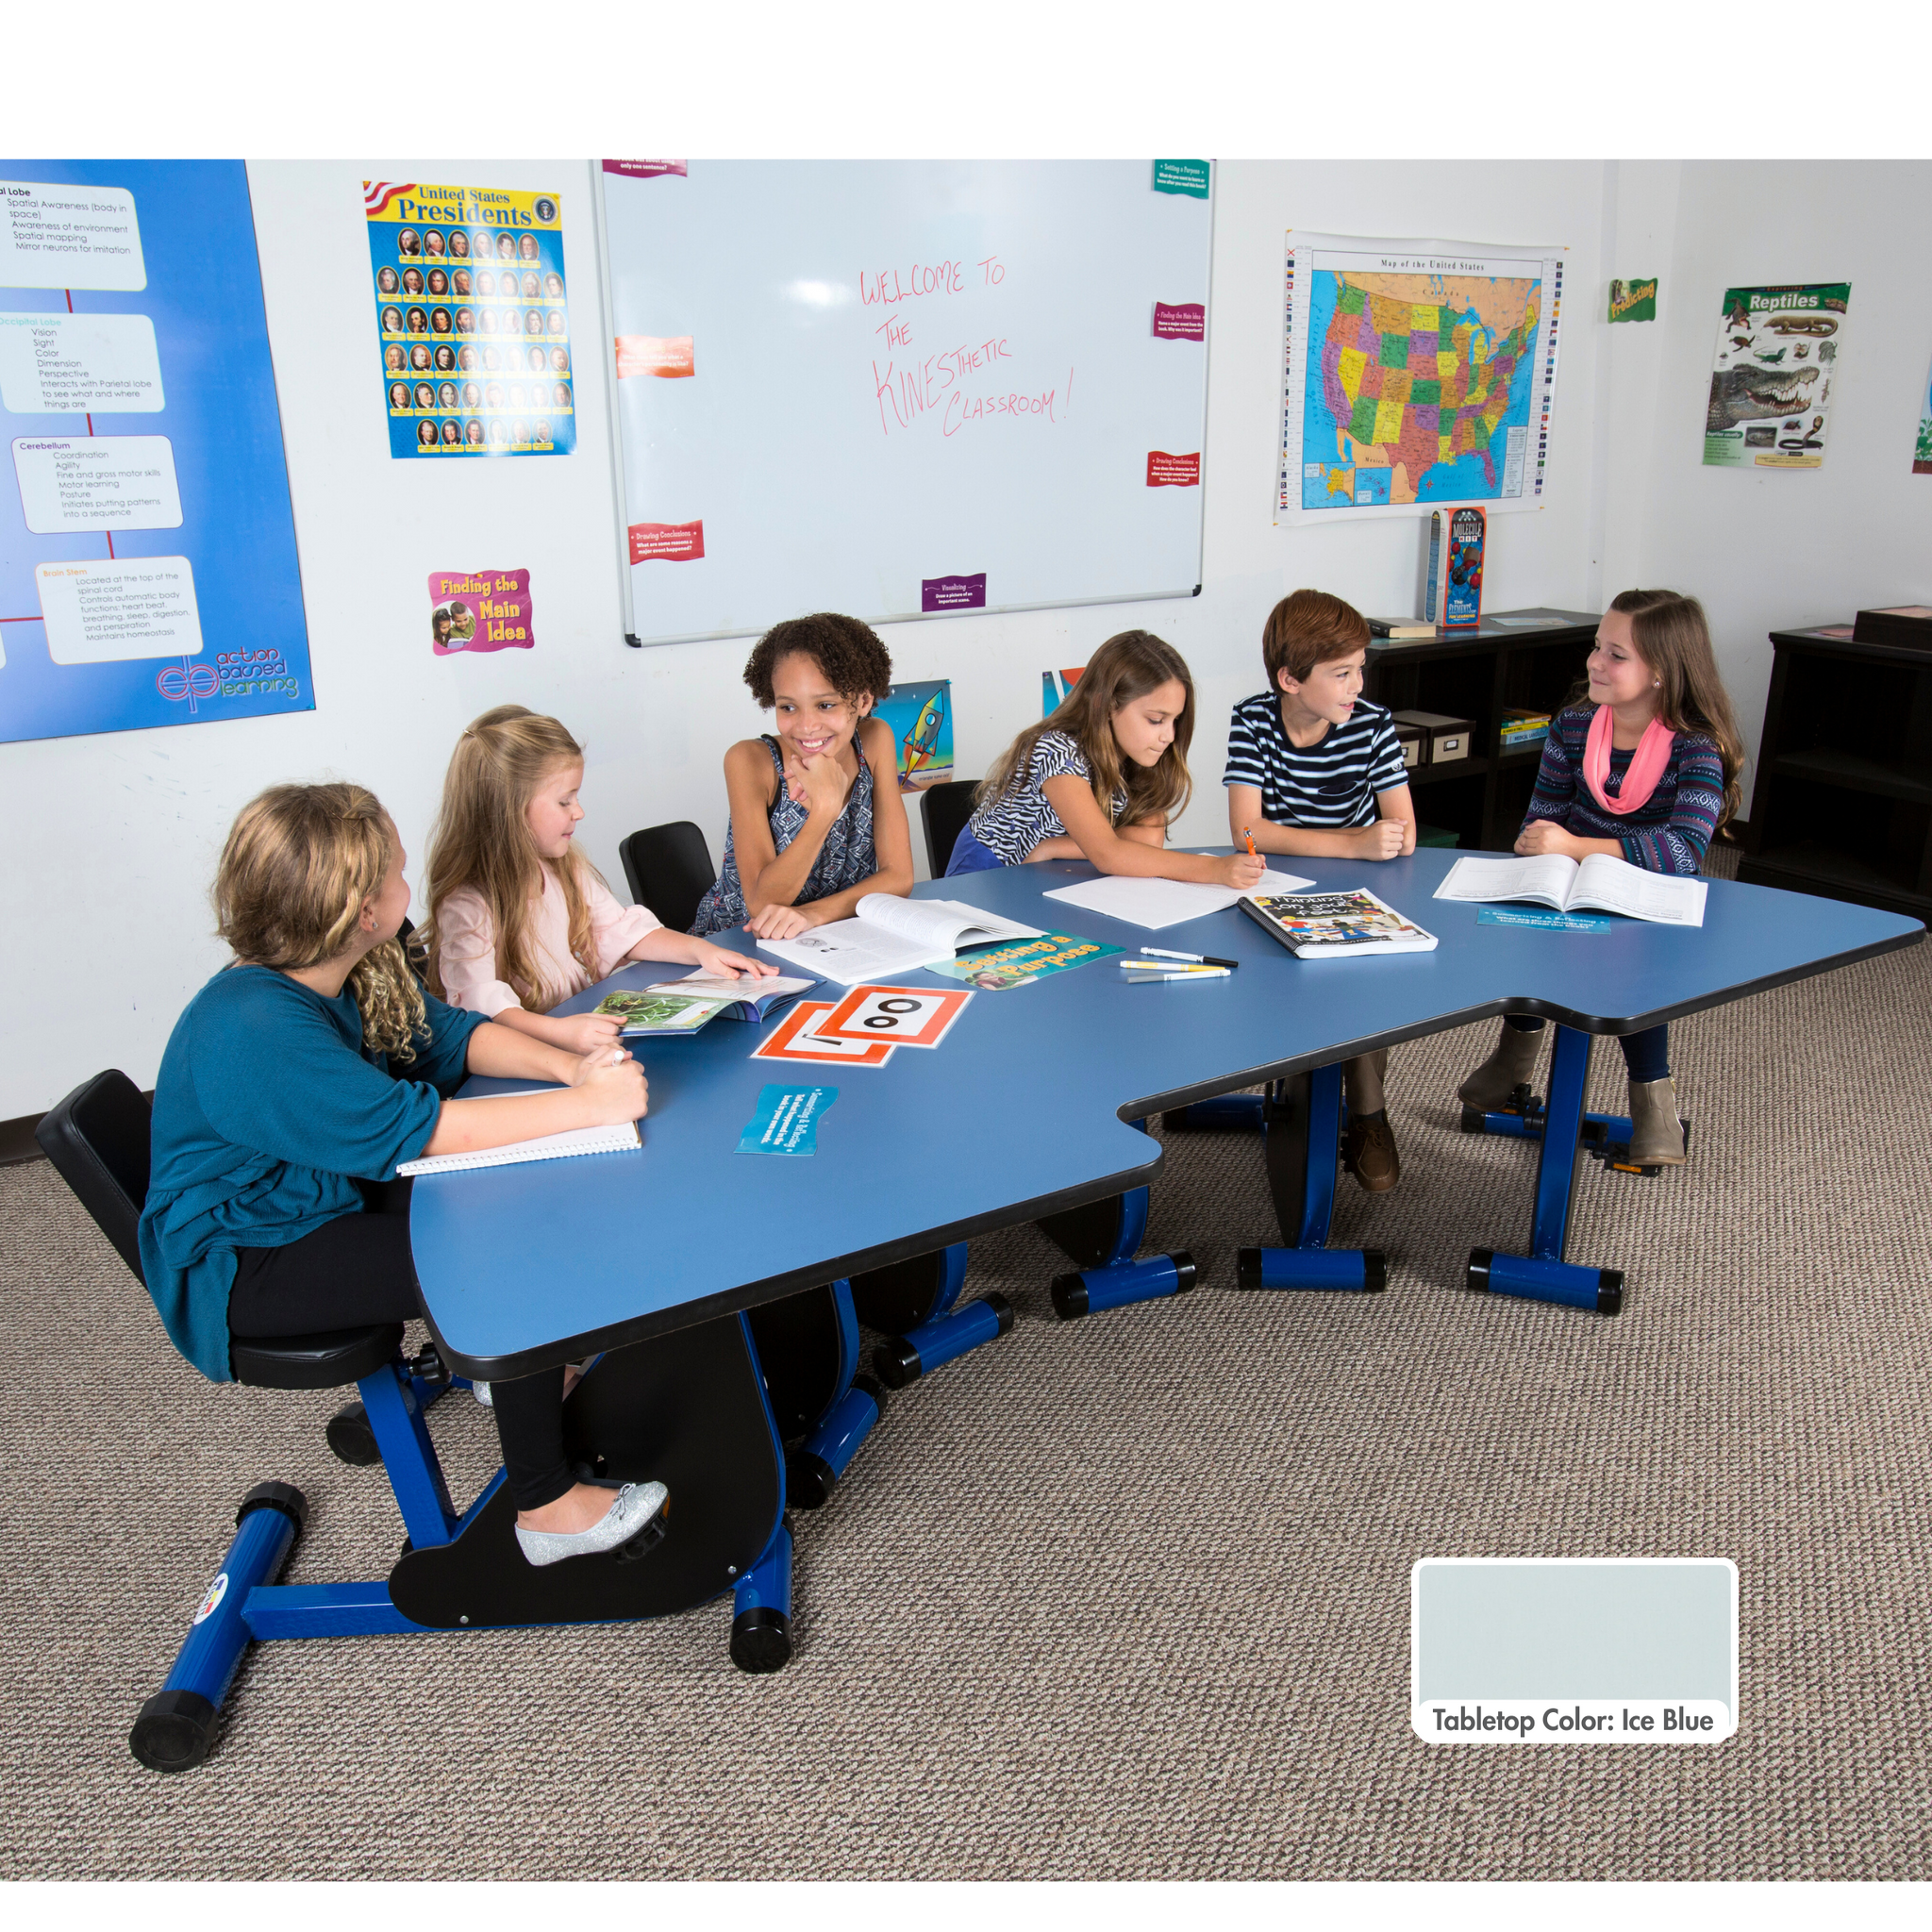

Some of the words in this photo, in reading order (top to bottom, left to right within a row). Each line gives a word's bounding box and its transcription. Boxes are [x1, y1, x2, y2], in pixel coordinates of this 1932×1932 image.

[8, 188, 30, 196] Lobe
[419, 186, 465, 200] United
[470, 189, 510, 204] States
[7, 198, 39, 208] Spatial
[42, 201, 89, 211] Awareness
[92, 203, 117, 213] (body
[9, 210, 42, 220] space)
[397, 198, 532, 226] Presidents
[12, 221, 60, 230] Awareness
[74, 224, 128, 233] environment
[13, 231, 44, 241] Spatial
[47, 234, 87, 243] mapping
[93, 246, 130, 255] imitation
[1381, 258, 1396, 268] Map
[1429, 259, 1457, 270] United
[1459, 262, 1485, 271] States
[860, 260, 964, 306] WELCOME
[977, 256, 1006, 285] TO
[1611, 281, 1655, 319] Predicting
[1750, 293, 1818, 312] Reptiles
[0, 317, 38, 326] Occipital
[40, 318, 61, 326] Lobe
[31, 328, 58, 337] Vision
[875, 314, 913, 351] THE
[33, 339, 55, 348] Sight
[35, 349, 58, 358] Color
[39, 370, 89, 378] Perspective
[873, 338, 1012, 435] KINESTHETIC
[44, 400, 70, 409] things
[943, 366, 1074, 437] CLASSROOM!
[20, 441, 70, 450] Cerebellum
[53, 451, 108, 459] Coordination
[56, 461, 80, 471] Agility
[57, 471, 74, 479] Fine
[96, 471, 116, 480] gross
[85, 479, 120, 489] learning
[60, 491, 92, 499] Posture
[61, 500, 93, 508] Initiates
[96, 499, 125, 508] putting
[127, 498, 160, 507] patterns
[63, 509, 79, 518] into
[90, 509, 131, 518] sequence
[660, 529, 691, 539] Conclusions
[1453, 523, 1482, 538] MOLECULE
[76, 576, 111, 586] Located
[124, 575, 137, 583] the
[140, 575, 154, 584] top
[441, 576, 491, 597] Finding
[495, 575, 519, 592] the
[78, 587, 102, 595] spinal
[79, 595, 113, 605] Controls
[115, 593, 157, 603] automatic
[159, 591, 180, 600] body
[81, 605, 121, 613] functions:
[122, 603, 143, 611] heart
[479, 599, 521, 620] Main
[1449, 604, 1472, 614] ELEMENTS
[104, 622, 150, 632] perspiration
[487, 620, 526, 642] Idea
[86, 632, 125, 641] Maintains
[126, 628, 175, 639] homeostasis
[216, 646, 279, 665] action
[220, 676, 298, 699] learning
[953, 941, 1058, 971] Setting
[1051, 935, 1074, 943] a
[998, 944, 1102, 976] Purpose
